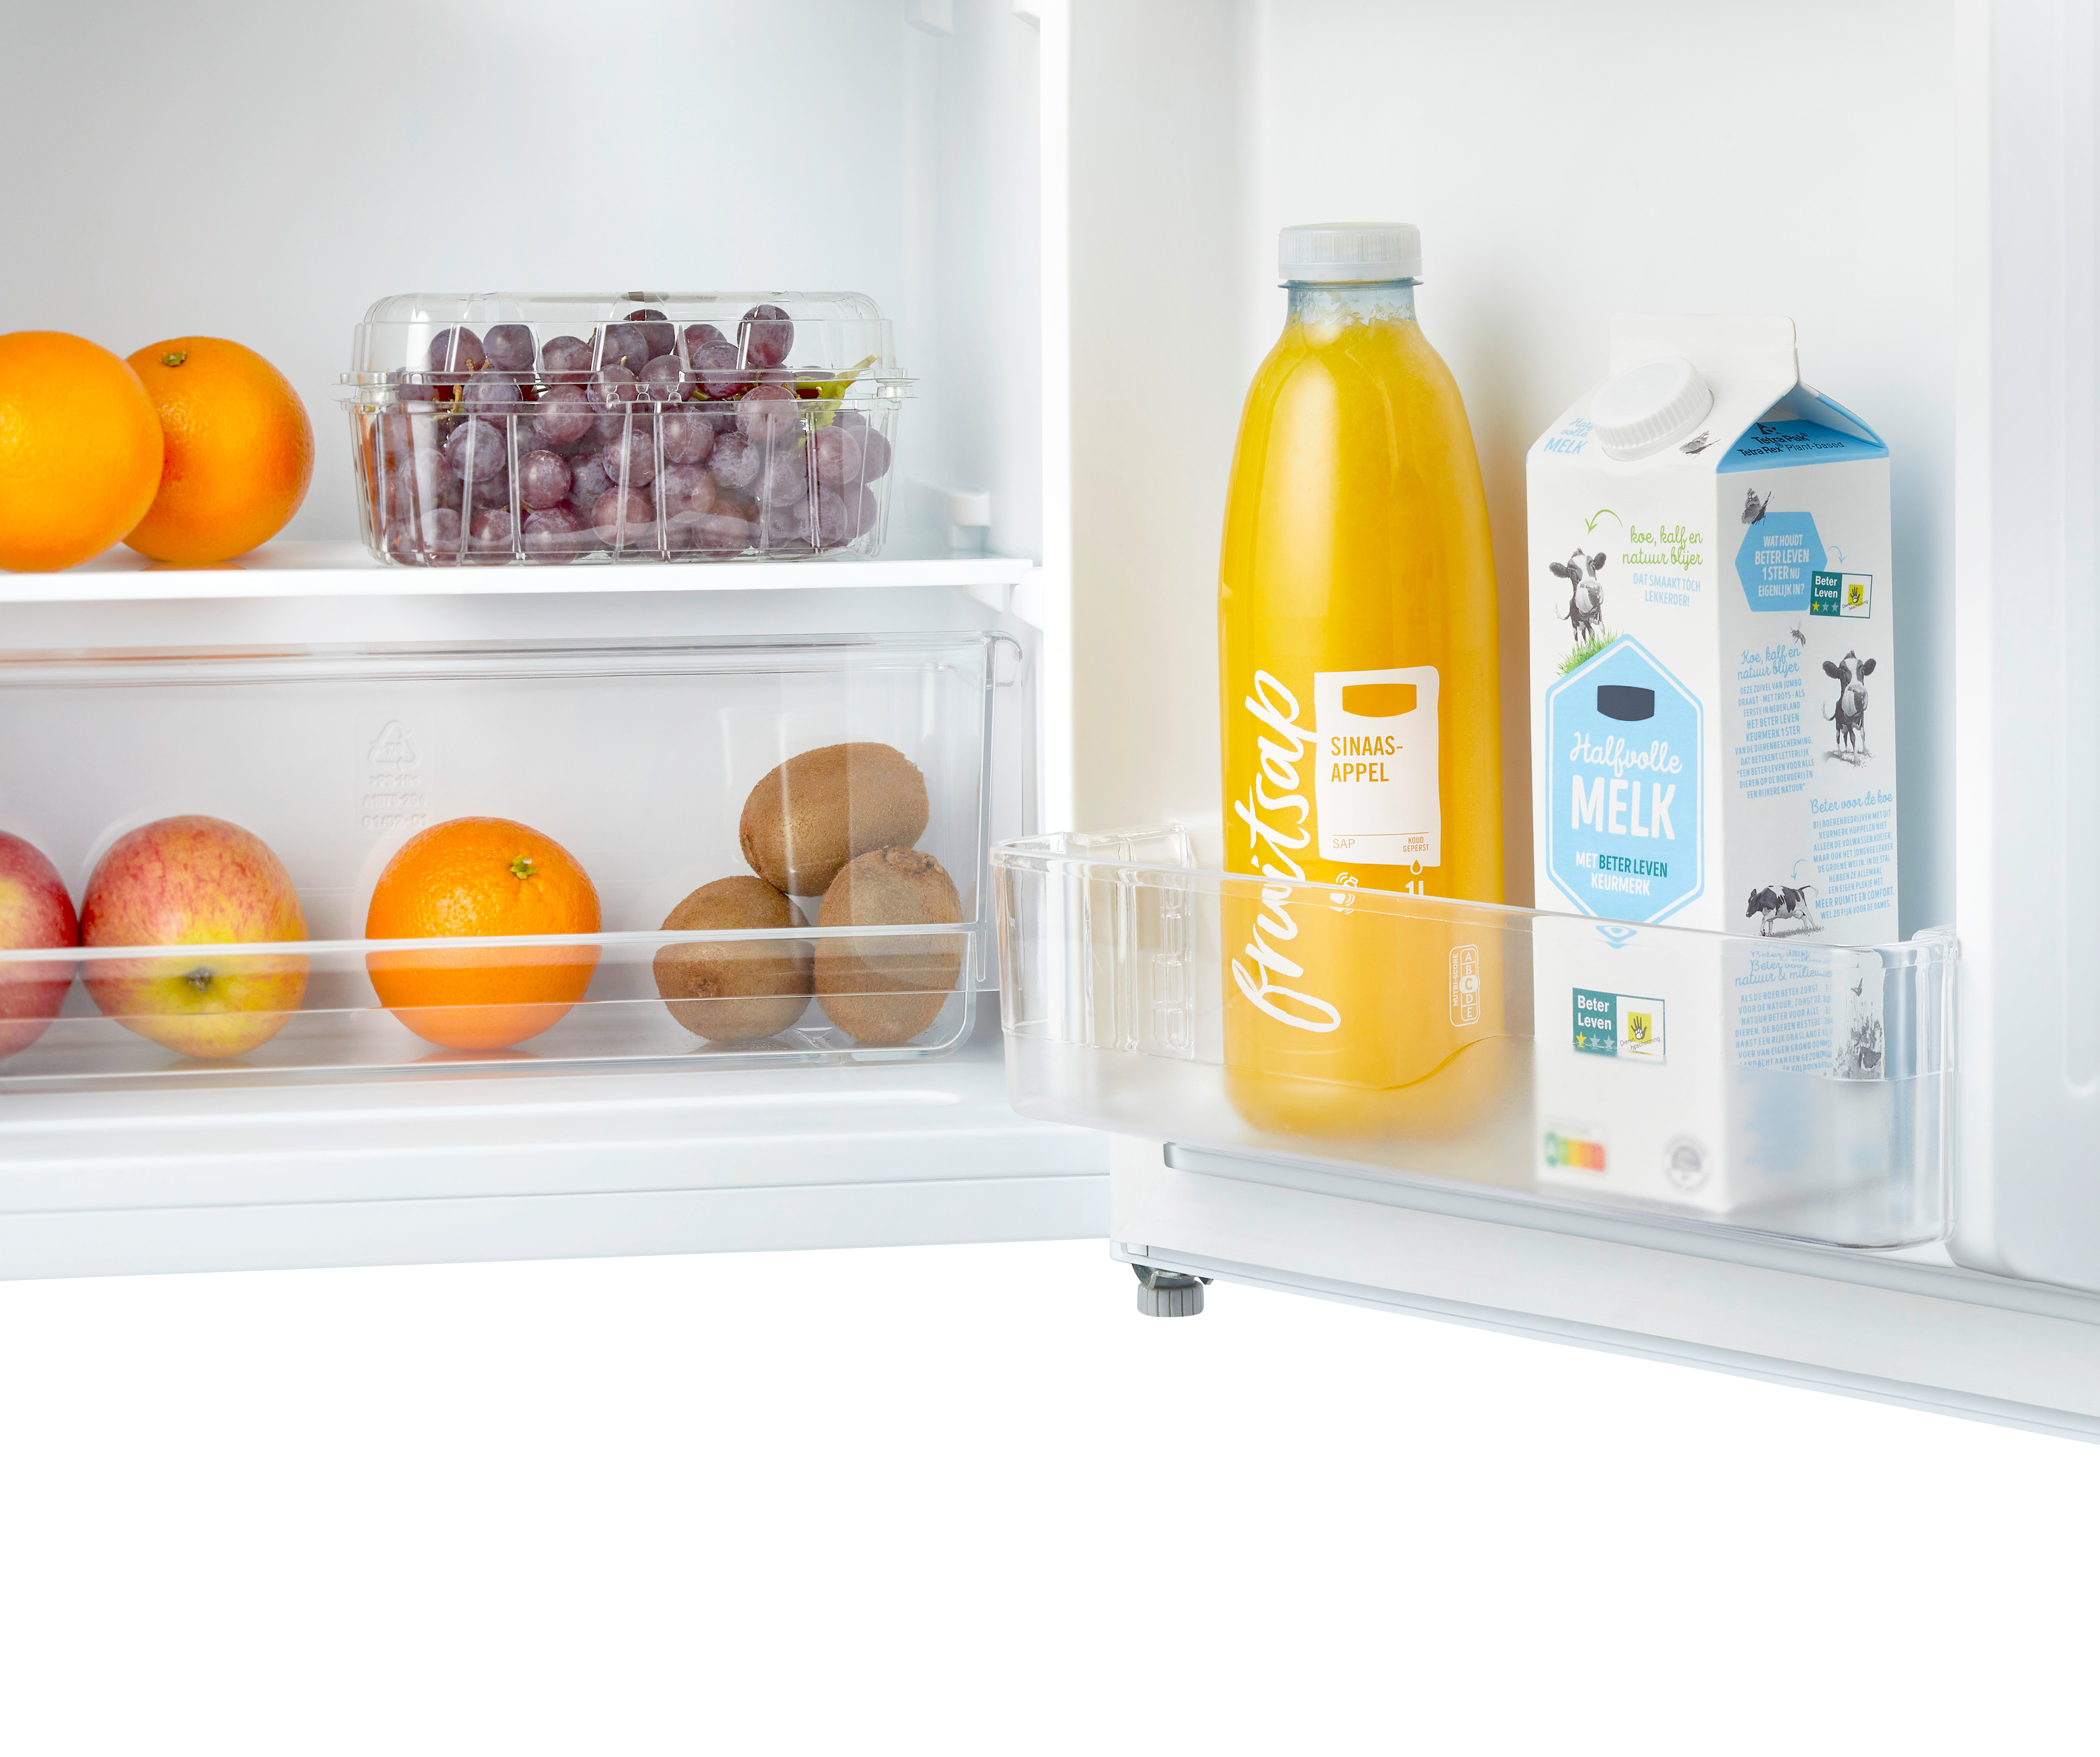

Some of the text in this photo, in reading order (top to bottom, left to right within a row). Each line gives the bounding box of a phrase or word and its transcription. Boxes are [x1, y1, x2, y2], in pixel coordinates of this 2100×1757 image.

[1561, 428, 1588, 437] volle
[1544, 438, 1588, 454] MELK
[1785, 442, 1844, 451] Plant-based
[1631, 525, 1703, 550] koe, kalf en
[1763, 535, 1803, 546] WAT HOUDT
[1623, 547, 1703, 571] natuur blijer
[1755, 549, 1809, 564] BETER LEVEN
[1762, 567, 1799, 580] 1 STER NU
[1815, 575, 1837, 586] Beter
[1633, 573, 1700, 592] DAT SMAAKT TÓCH
[1758, 583, 1804, 596] EIGENLIJK IN?
[1645, 590, 1690, 607] LEKKERDER!
[1815, 588, 1837, 598] Leven
[1742, 645, 1801, 665] Koe, kalf en
[1737, 661, 1800, 680] natuur blijer
[1754, 684, 1770, 692] ZUIVEL
[1784, 679, 1801, 688] JUMBO
[1738, 696, 1758, 706] DRAAGT
[1774, 692, 1790, 700] TROTS
[1744, 707, 1761, 716] EERSTE
[1769, 702, 1800, 712] NEDERLAND
[1747, 713, 1799, 728] HET BETER LEVEN
[1746, 729, 1779, 741] KEURMERK
[1785, 726, 1800, 735] STER
[1331, 735, 1403, 756] SINAAS-
[1570, 731, 1682, 778] Halfvolle
[1751, 753, 1777, 763] BETEKENT
[1779, 749, 1809, 759] LETTERLIJK
[1331, 762, 1389, 782] APPEL
[1751, 766, 1767, 775] BETER
[1769, 763, 1785, 772] LEVEN
[1786, 761, 1801, 769] VOOR
[1802, 759, 1814, 767] ALLE
[1739, 779, 1759, 788] DIEREN
[1776, 772, 1805, 782] BOERDERIJ
[1758, 787, 1780, 796] RIJKERE
[1572, 774, 1676, 840] MELK
[1810, 790, 1893, 814] Beter voor de koe
[1822, 812, 1871, 827] BOERENBEDRIJVEN
[1872, 811, 1882, 819] MET
[1819, 829, 1848, 838] KEURMERK
[1849, 824, 1875, 833] HUPPELEN
[1232, 669, 1341, 1032] fruitsap
[1333, 839, 1355, 849] SAP
[1403, 844, 1429, 852] GEPERST
[1814, 842, 1833, 851] ALLEEN
[1842, 836, 1873, 846] VOLWASSEN
[1854, 846, 1875, 856] JONGVEE
[1876, 843, 1893, 852] LEKKER
[1576, 851, 1667, 878] MET BETER LEVEN
[1826, 862, 1847, 871] GROENE
[1829, 873, 1849, 882] HEBBEN
[1857, 867, 1882, 877] ALLEMAAL
[1592, 873, 1650, 896] KEURMERK
[1840, 883, 1855, 892] EIGEN
[1856, 879, 1872, 890] PLEKJE
[1816, 898, 1832, 907] MEER
[1835, 894, 1857, 905] RUIMTE
[1859, 892, 1866, 901] EN
[1853, 905, 1866, 913] VOOR
[1465, 952, 1472, 961] A
[1466, 965, 1472, 975] B
[1750, 959, 1783, 971] Beter
[1465, 978, 1473, 990] C
[1735, 968, 1818, 987] natuur & milieu
[1466, 994, 1473, 1004] D
[1763, 991, 1779, 999] BOER
[1781, 988, 1798, 997] BETER
[1800, 984, 1817, 994] ZORGT
[1578, 995, 1609, 1012] Beter
[1467, 1007, 1473, 1017] E
[1578, 1012, 1612, 1030] Leven
[1620, 1037, 1635, 1047] Dieren
